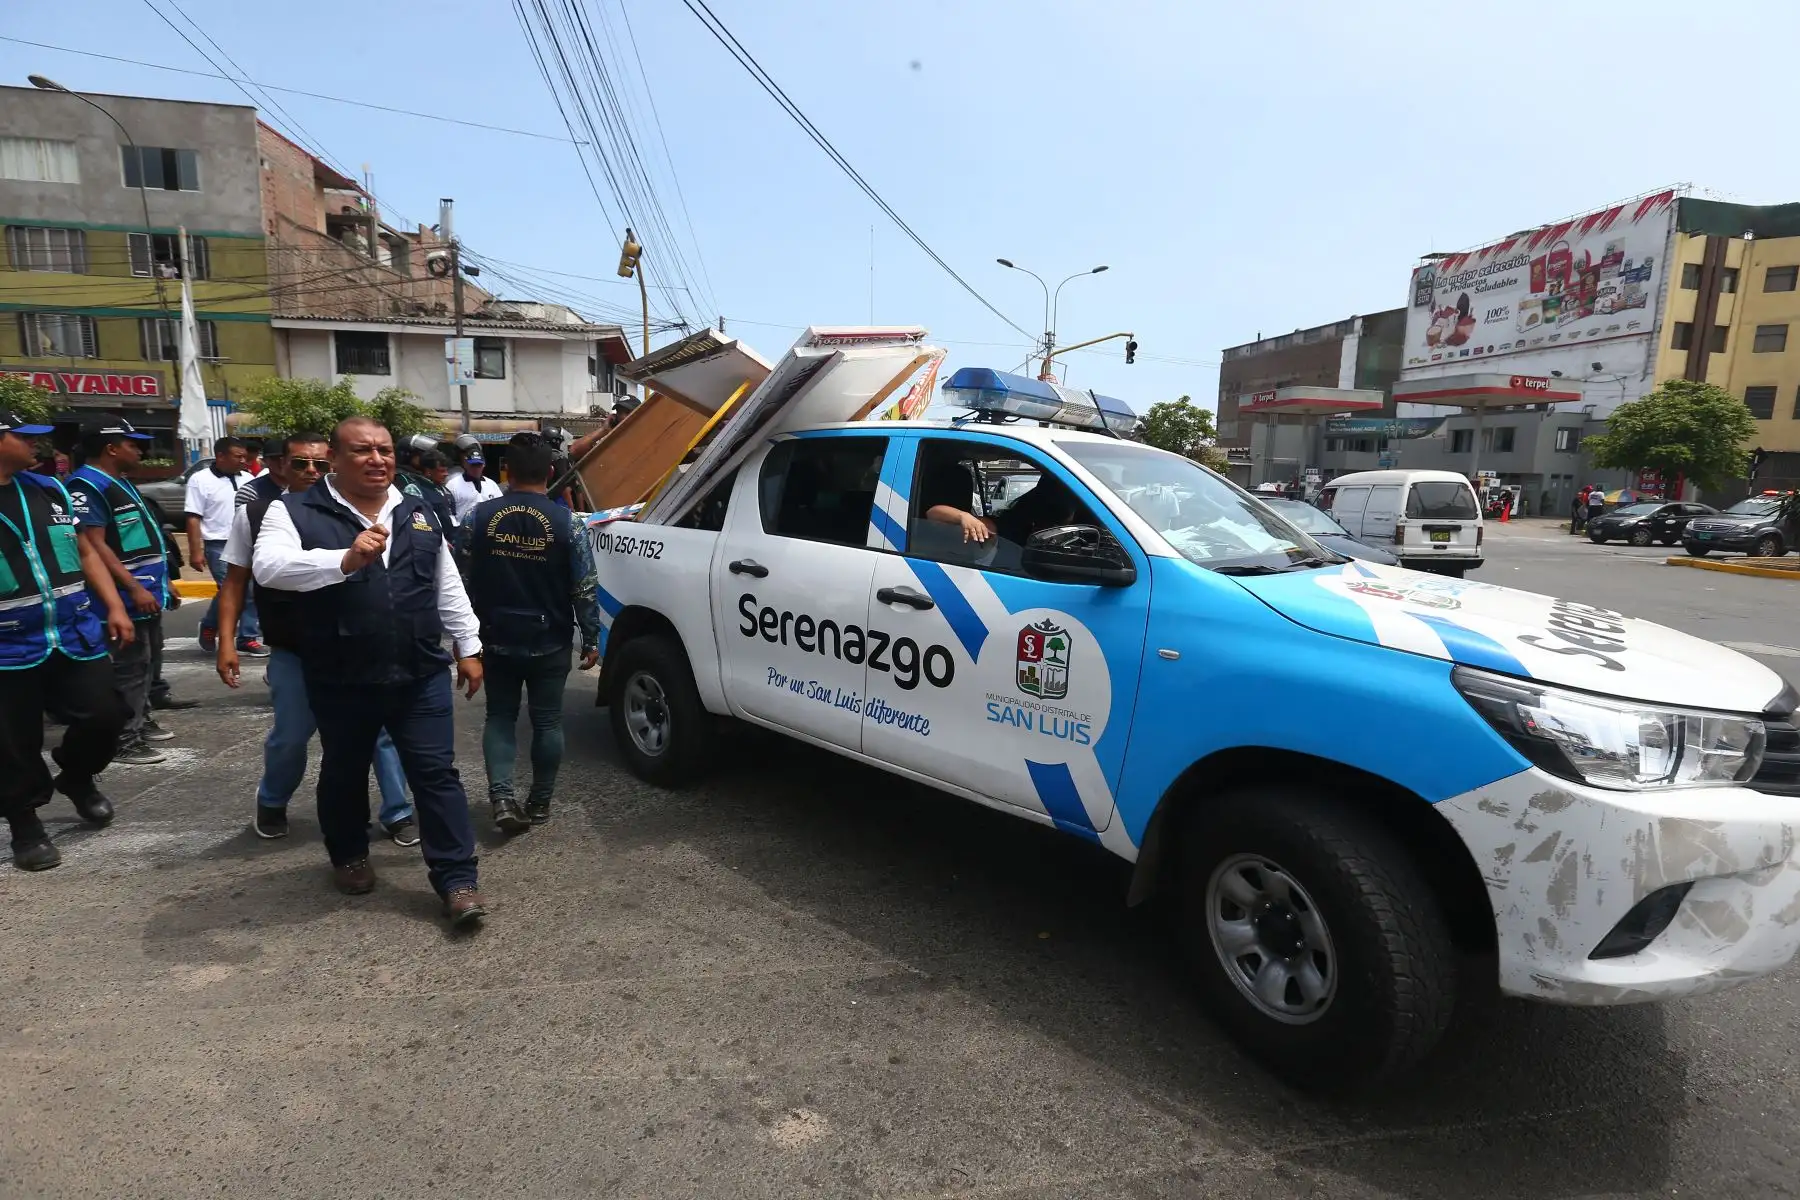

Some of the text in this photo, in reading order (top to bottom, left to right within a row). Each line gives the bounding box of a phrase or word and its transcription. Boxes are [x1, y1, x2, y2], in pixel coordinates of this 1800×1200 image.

[1434, 276, 1448, 289] La
[1449, 268, 1478, 286] mejor
[1479, 253, 1531, 278] selección
[1441, 277, 1487, 295] de Productos
[1474, 278, 1518, 294] Saludables
[58, 373, 159, 396] YANG
[1525, 377, 1549, 391] terpel
[487, 505, 526, 536] MUNICIPALIDAD
[527, 506, 553, 533] DISTRITAL
[495, 533, 546, 547] SAN LUIS
[596, 531, 664, 560] (01) 250-1152
[738, 593, 955, 690] Serenazgo
[767, 667, 931, 736] Por un San Luis diferente
[985, 692, 1091, 723] MUNICIPALIDAD DISTRITAL DE
[986, 702, 1091, 745] SAN LUIS
